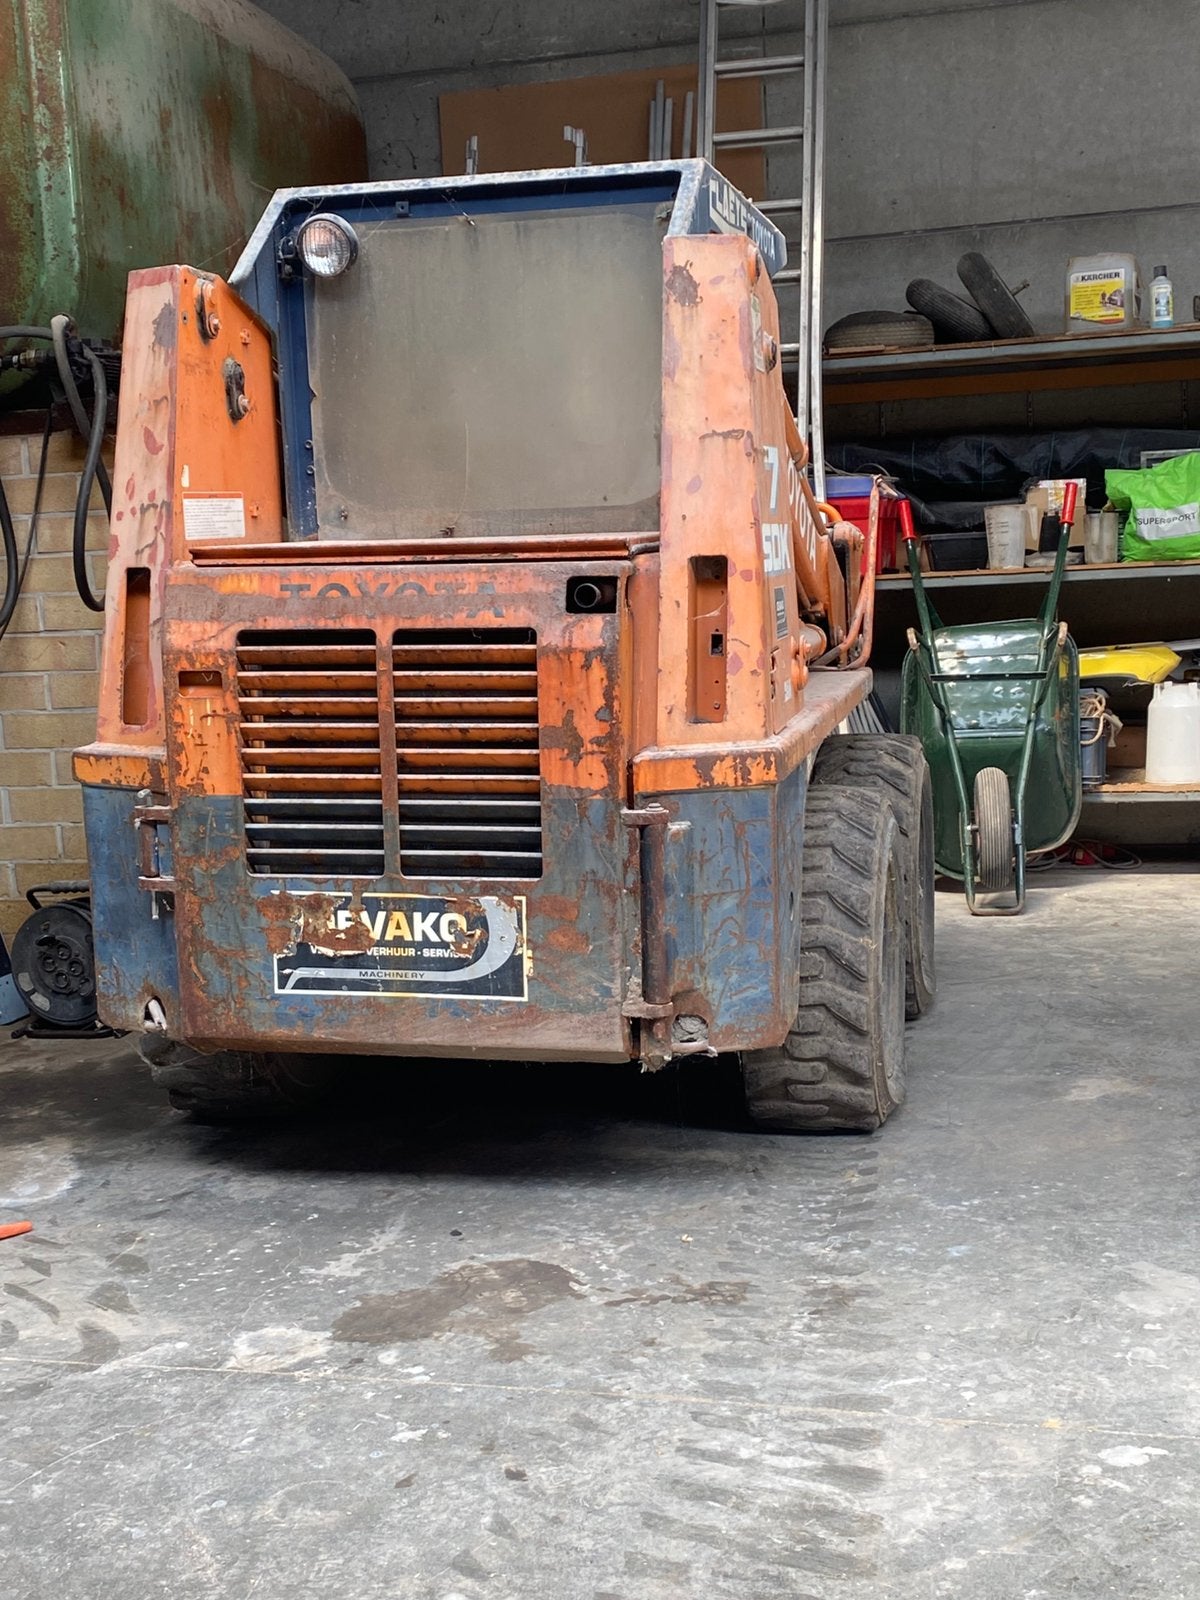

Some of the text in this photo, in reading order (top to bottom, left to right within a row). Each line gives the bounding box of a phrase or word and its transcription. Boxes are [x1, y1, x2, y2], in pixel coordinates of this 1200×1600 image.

[762, 445, 778, 512] 7
[786, 445, 817, 571] OYOTA
[1137, 512, 1196, 525] SUPERSPORT
[762, 523, 791, 573] SDK
[326, 909, 468, 942] EVAKO
[366, 946, 416, 957] VERHUUR
[358, 970, 425, 980] MACHINERY
